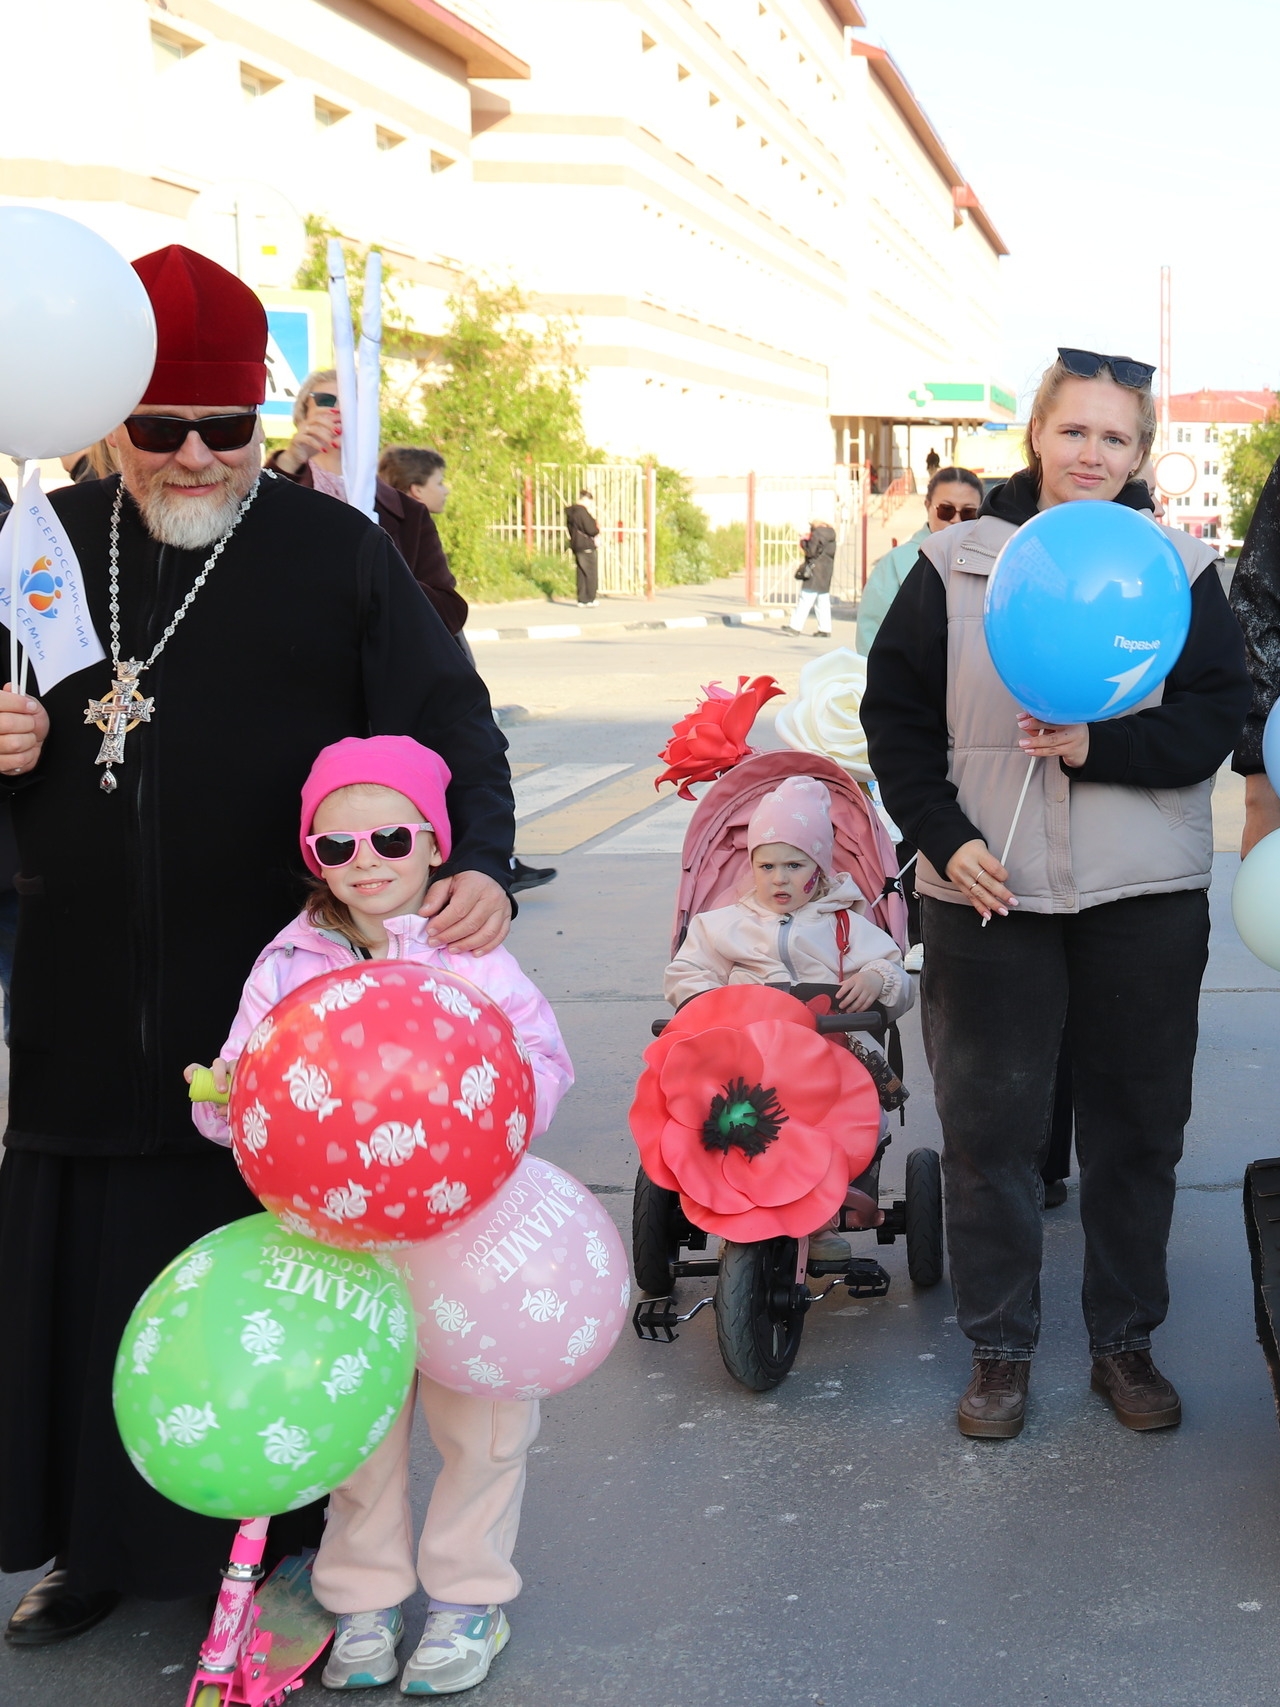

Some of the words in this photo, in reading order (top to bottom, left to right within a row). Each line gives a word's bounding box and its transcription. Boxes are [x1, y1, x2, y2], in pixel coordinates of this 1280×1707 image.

[29, 505, 89, 648] ВСЕРОССИЙСКИЙ
[16, 607, 46, 661] СЕМЬИ
[1113, 634, 1161, 653] Первые
[480, 1189, 576, 1283] МАМЕ
[264, 1257, 388, 1334] МАМЕ
